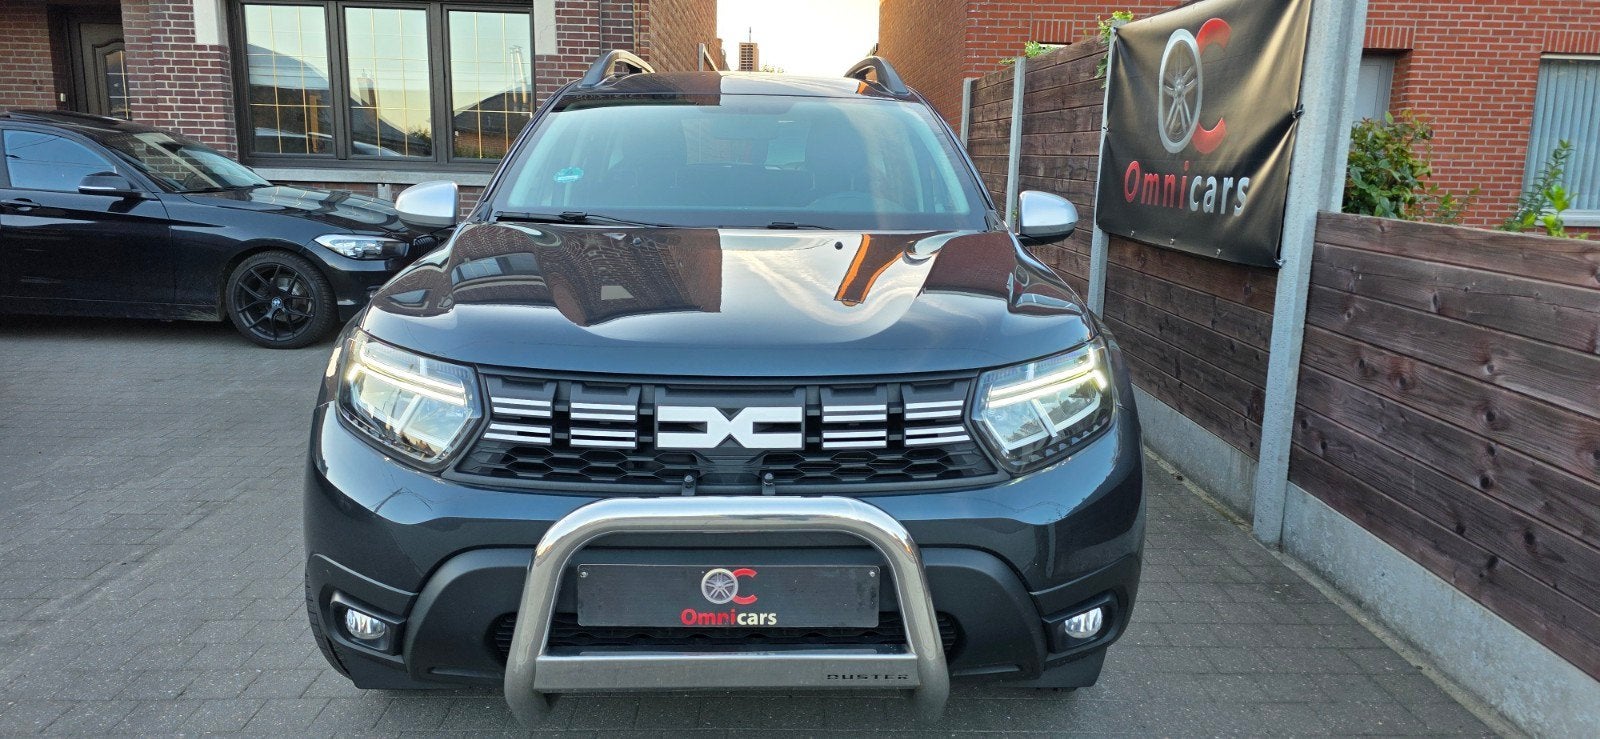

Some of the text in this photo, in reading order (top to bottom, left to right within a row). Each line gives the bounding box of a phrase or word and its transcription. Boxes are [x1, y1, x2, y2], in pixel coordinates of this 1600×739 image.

[1123, 160, 1250, 217] Omnicars
[681, 608, 778, 626] Omnicars
[826, 673, 910, 681] DUSTER
